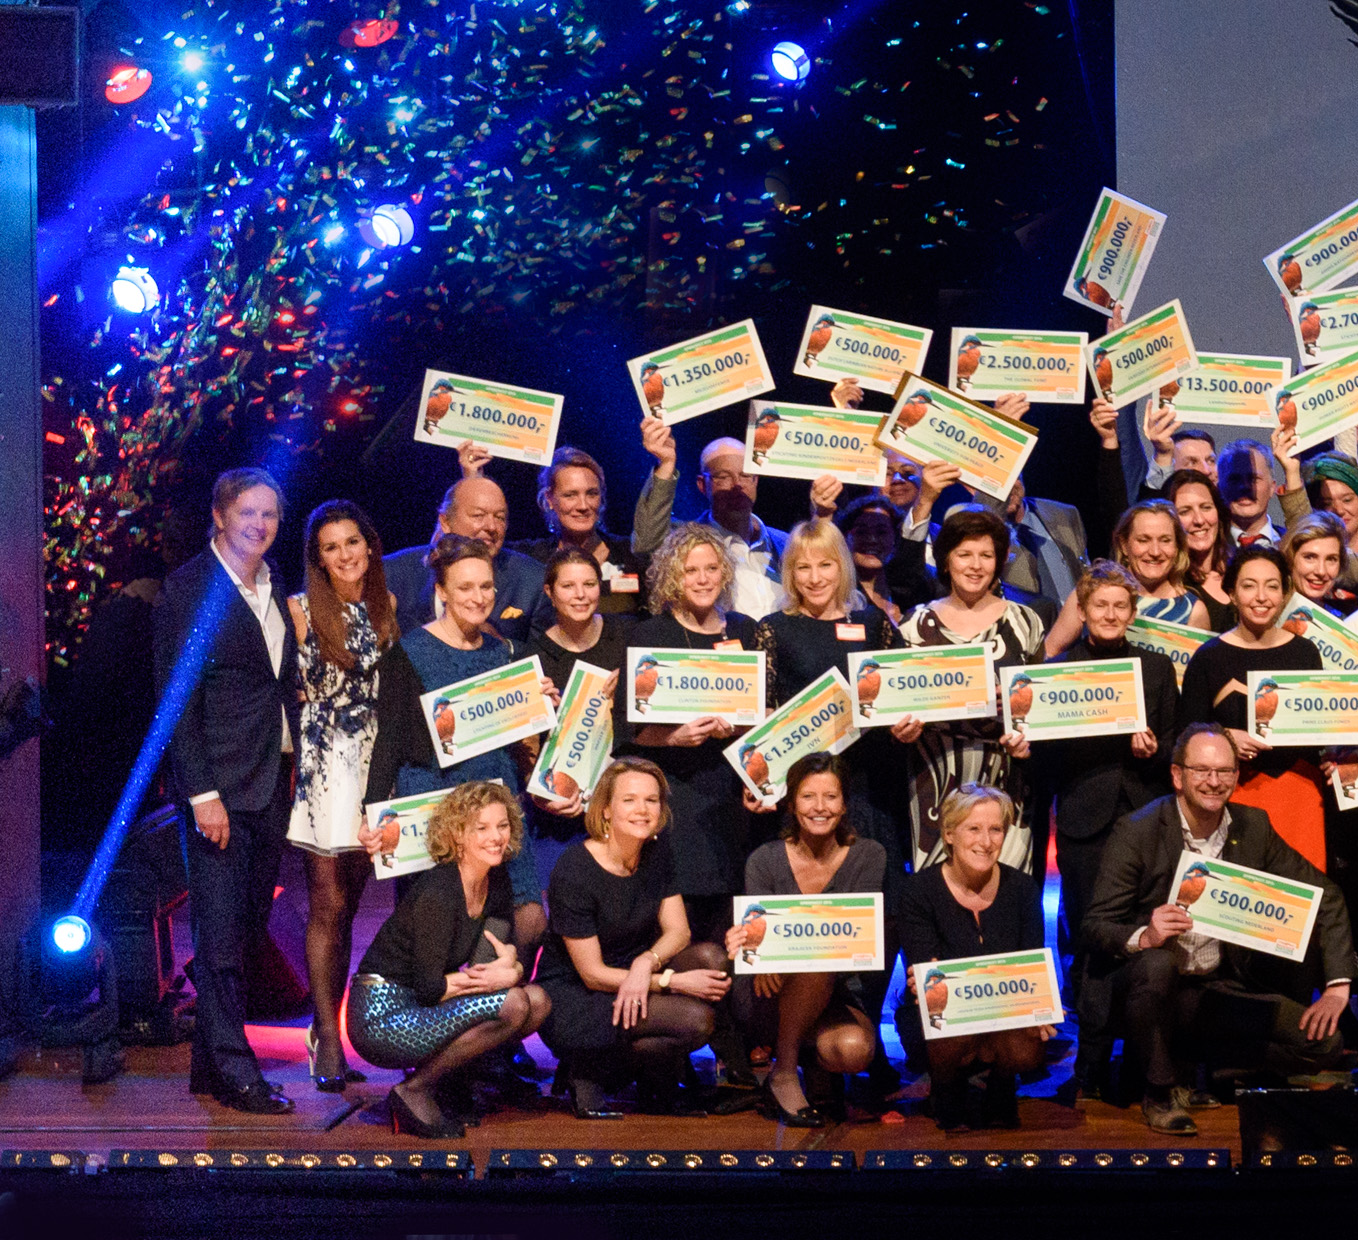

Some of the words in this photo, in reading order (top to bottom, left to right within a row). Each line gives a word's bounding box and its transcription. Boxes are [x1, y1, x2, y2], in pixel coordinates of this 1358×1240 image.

[1098, 214, 1134, 281] €900.000,-
[834, 336, 907, 365] €500.000,-
[1115, 334, 1175, 371] €500.000,-
[662, 351, 752, 389] €1.350.000,-
[978, 355, 1075, 374] €2.500.000,-
[448, 401, 545, 435] €1.800.000,-
[784, 427, 869, 452] €500.000,-
[928, 416, 1005, 465] €500.000,-
[657, 675, 753, 693] €1.800.000,-
[888, 672, 973, 690] €500.000,-
[459, 690, 531, 722] €500.000,-
[1038, 687, 1123, 706] €900.000,-
[1058, 709, 1084, 719] MAMA
[1086, 708, 1108, 718] CASH
[763, 700, 846, 762] €1.350.000,-
[806, 737, 822, 751] IVN
[1209, 887, 1293, 924] €500.000,-
[773, 921, 862, 940] €500.000,-
[954, 980, 1038, 1000] €500.000,-
